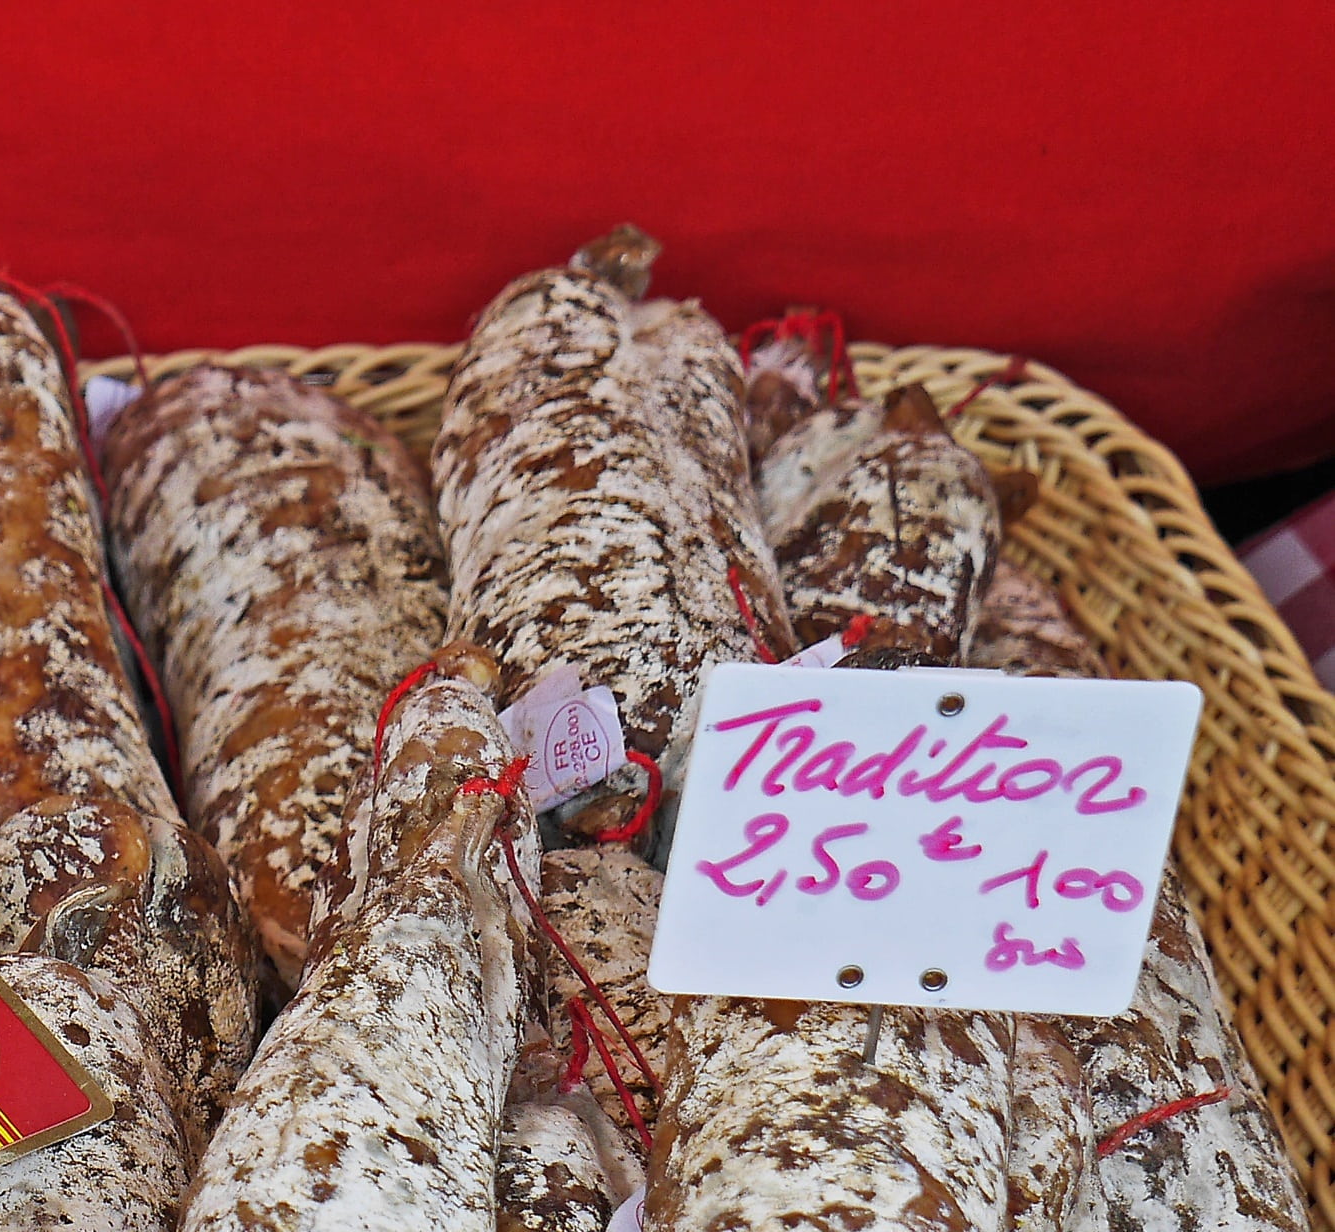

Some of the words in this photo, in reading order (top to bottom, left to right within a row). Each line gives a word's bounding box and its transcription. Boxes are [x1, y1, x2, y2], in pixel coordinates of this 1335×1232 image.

[554, 740, 569, 771] FR
[581, 730, 601, 761] CE
[713, 698, 1148, 815] Tradition
[695, 812, 900, 906] 2,50
[918, 816, 982, 861] €
[978, 849, 1144, 912] 100
